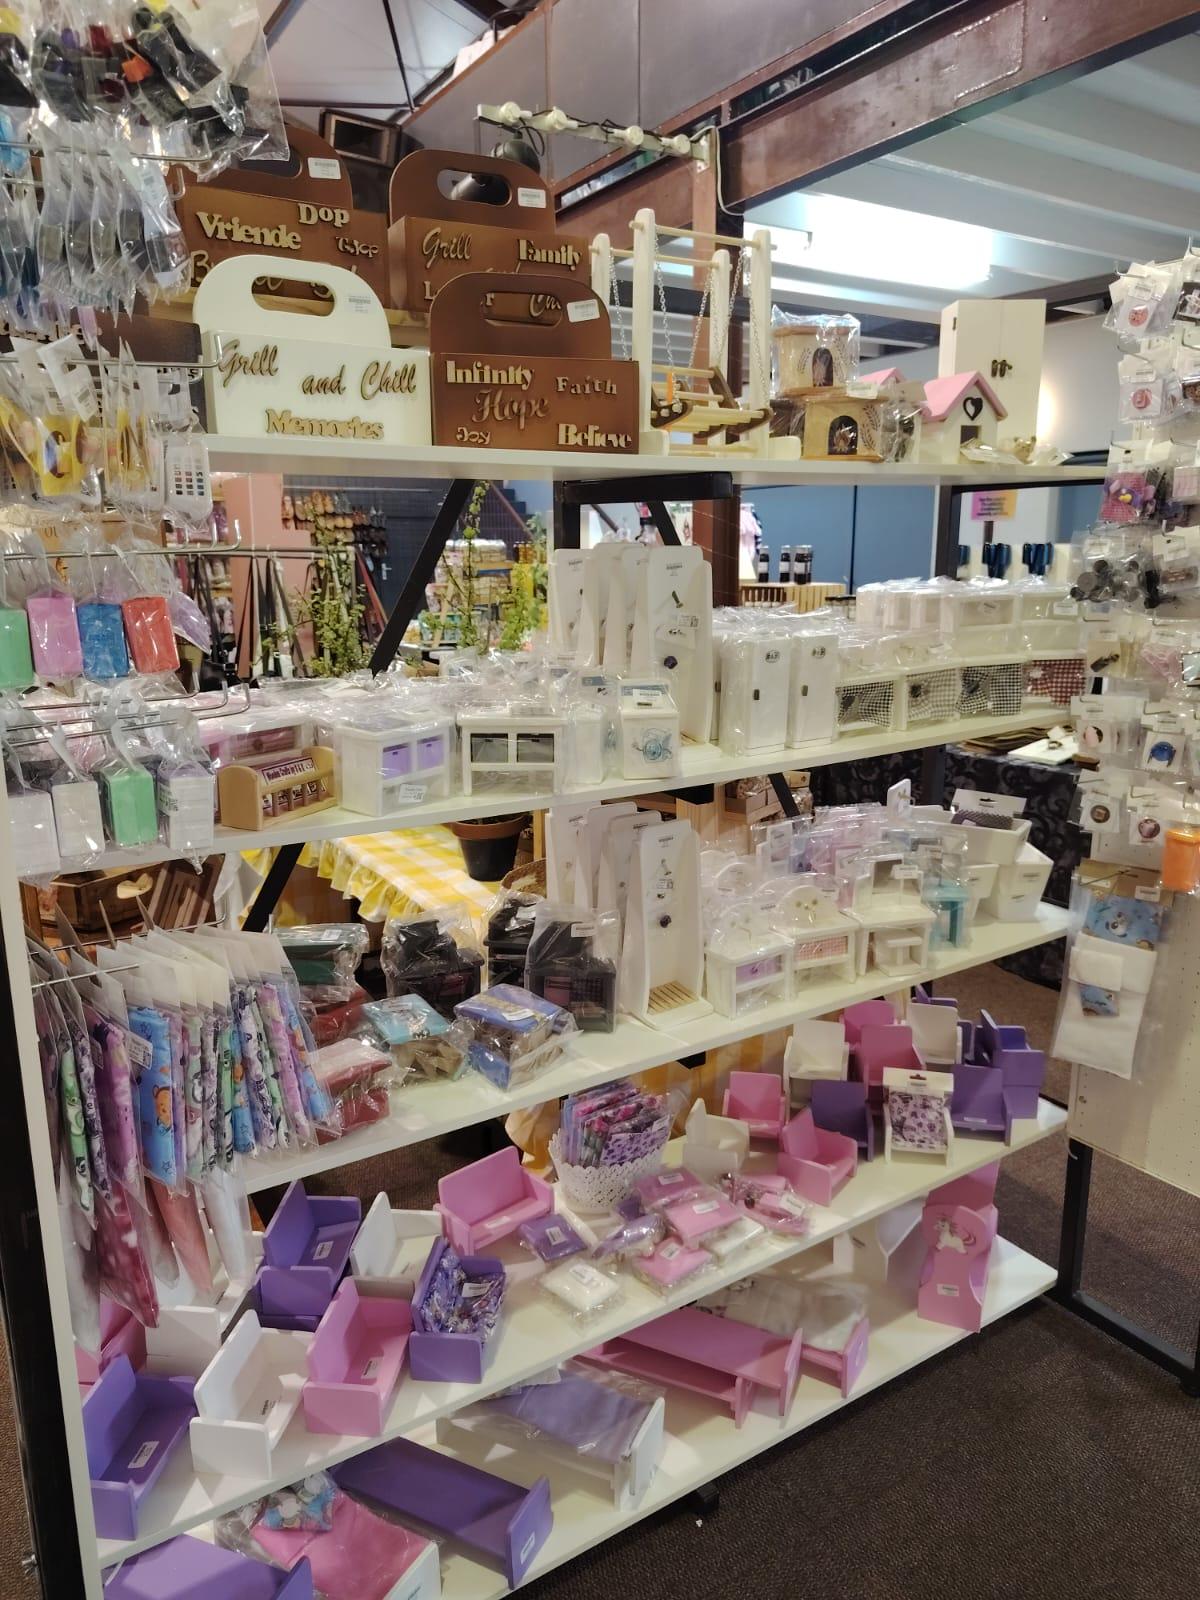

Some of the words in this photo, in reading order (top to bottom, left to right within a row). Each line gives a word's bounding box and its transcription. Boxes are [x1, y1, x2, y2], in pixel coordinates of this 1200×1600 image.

[196, 210, 301, 250] Vriende
[297, 202, 350, 228] Dop
[422, 227, 472, 269] Grill
[517, 239, 582, 271] Family
[217, 339, 279, 388] Grill
[301, 364, 346, 395] and
[360, 361, 417, 400] Chill
[446, 360, 534, 391] Infinity
[556, 376, 617, 395] Faith
[266, 409, 384, 440] Memories
[472, 389, 549, 430] Hope
[456, 427, 491, 445] Joy
[558, 424, 632, 449] Believe
